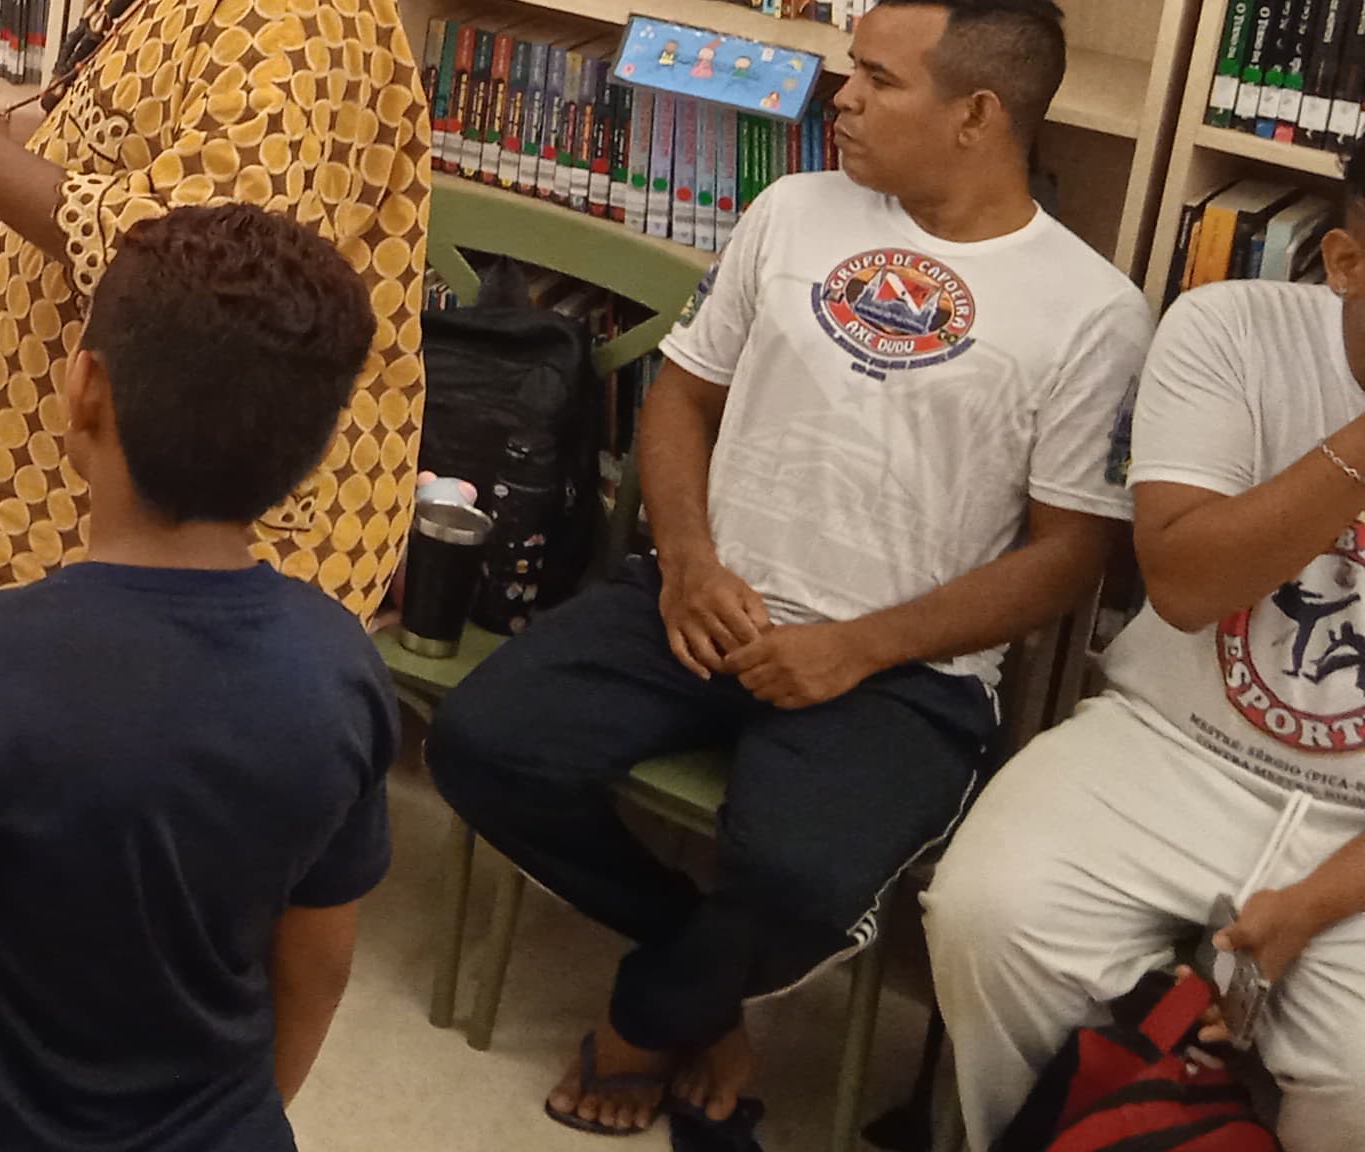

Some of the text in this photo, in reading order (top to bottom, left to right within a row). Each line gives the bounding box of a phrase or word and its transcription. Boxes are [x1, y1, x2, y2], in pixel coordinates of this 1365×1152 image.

[830, 253, 968, 330] GRUPO DE CAPOEIRA
[877, 338, 915, 354] DUDU
